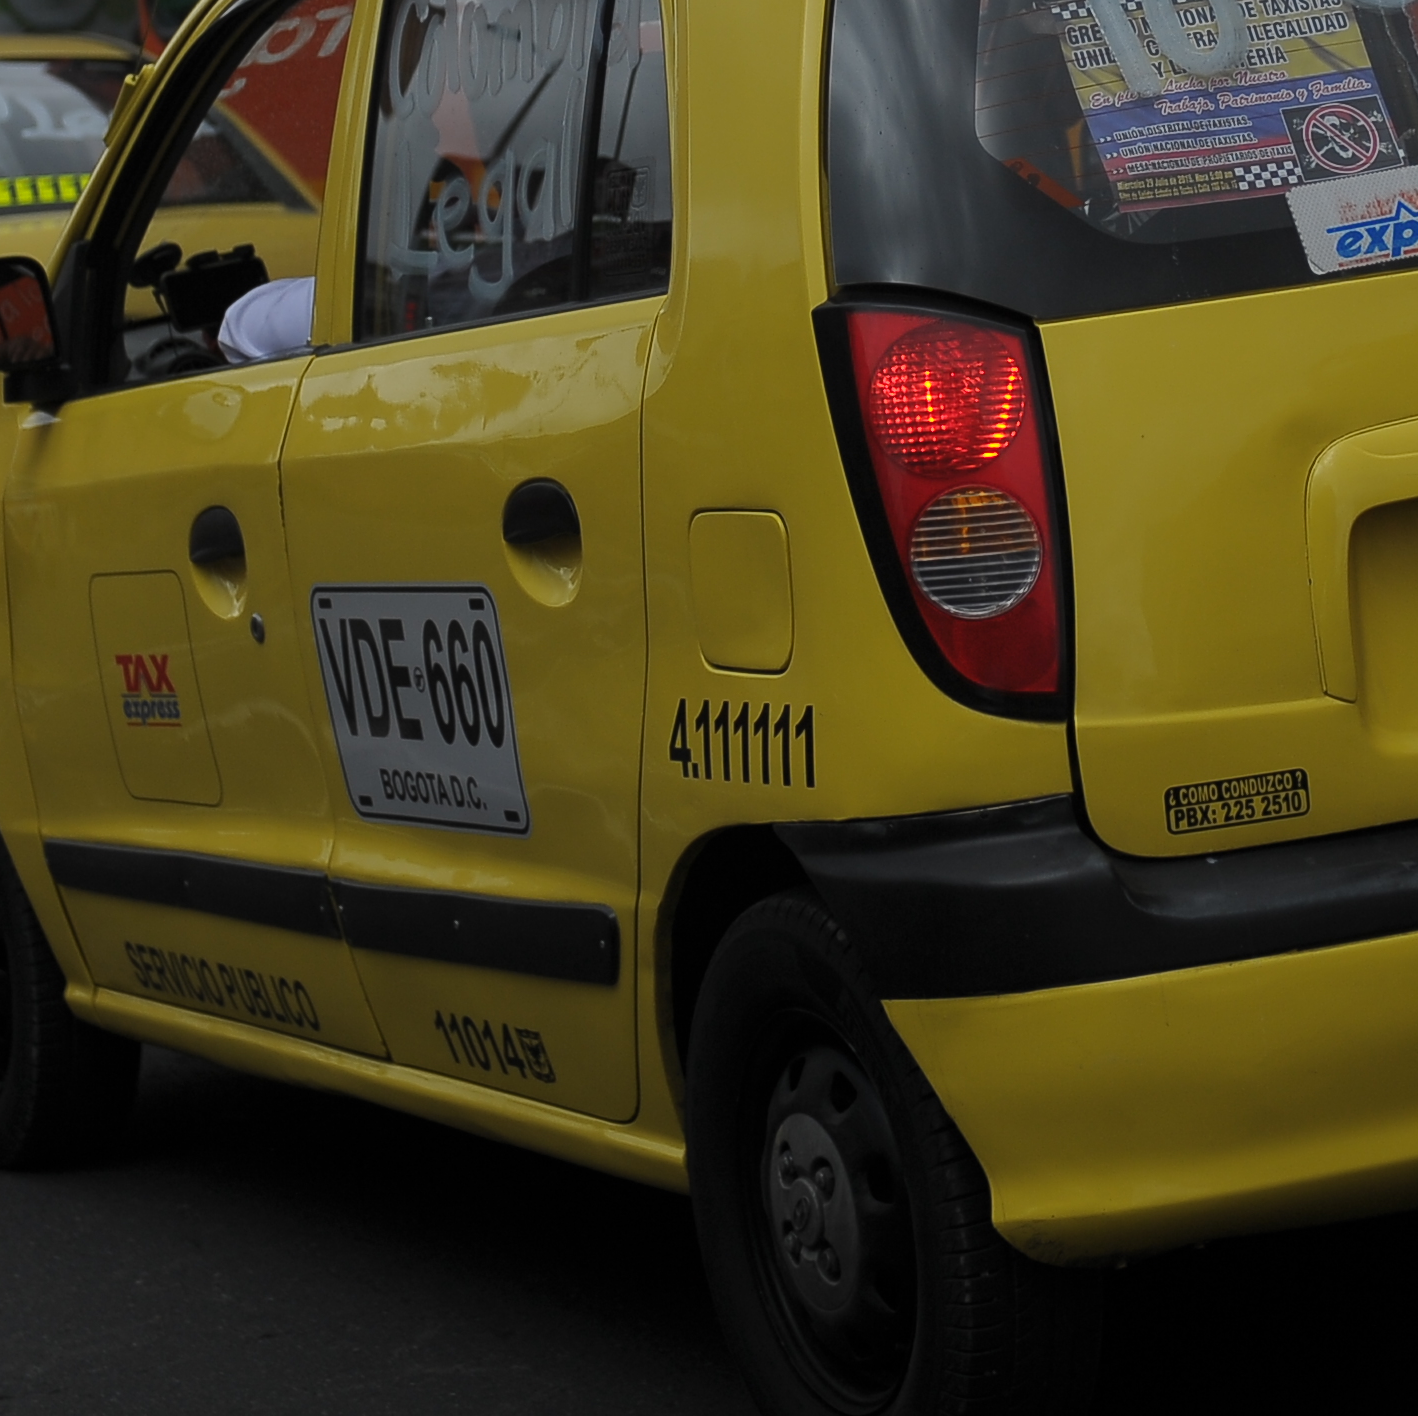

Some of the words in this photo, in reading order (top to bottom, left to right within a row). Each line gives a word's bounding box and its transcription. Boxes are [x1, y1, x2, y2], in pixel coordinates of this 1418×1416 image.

[1246, 11, 1349, 42] ILEGALIDAD
[1090, 93, 1112, 109] En
[1162, 76, 1206, 95] Lucha
[1208, 75, 1230, 91] por
[1234, 70, 1287, 85] Nuestro
[1217, 89, 1294, 109] Patrimonio
[1296, 87, 1308, 102] y
[1114, 127, 1146, 142] UNIÓN
[1147, 120, 1192, 136] DISTRITAL
[1194, 119, 1205, 131] DE
[1120, 143, 1152, 158] UNIÓN
[1152, 138, 1197, 152] NACIONAL
[1198, 136, 1211, 148] DE
[1126, 162, 1151, 175] MESA
[123, 699, 181, 725] express
[669, 697, 815, 789] 4.111111
[379, 768, 452, 807] BOGOTA
[449, 774, 488, 811] D.C.
[1174, 805, 1218, 830] PBX:
[1221, 798, 1256, 823] 225
[1260, 791, 1302, 817] 2510
[124, 940, 224, 1008] SERVICIO
[216, 962, 321, 1031] PUBLICO
[434, 1009, 527, 1079] 11014
